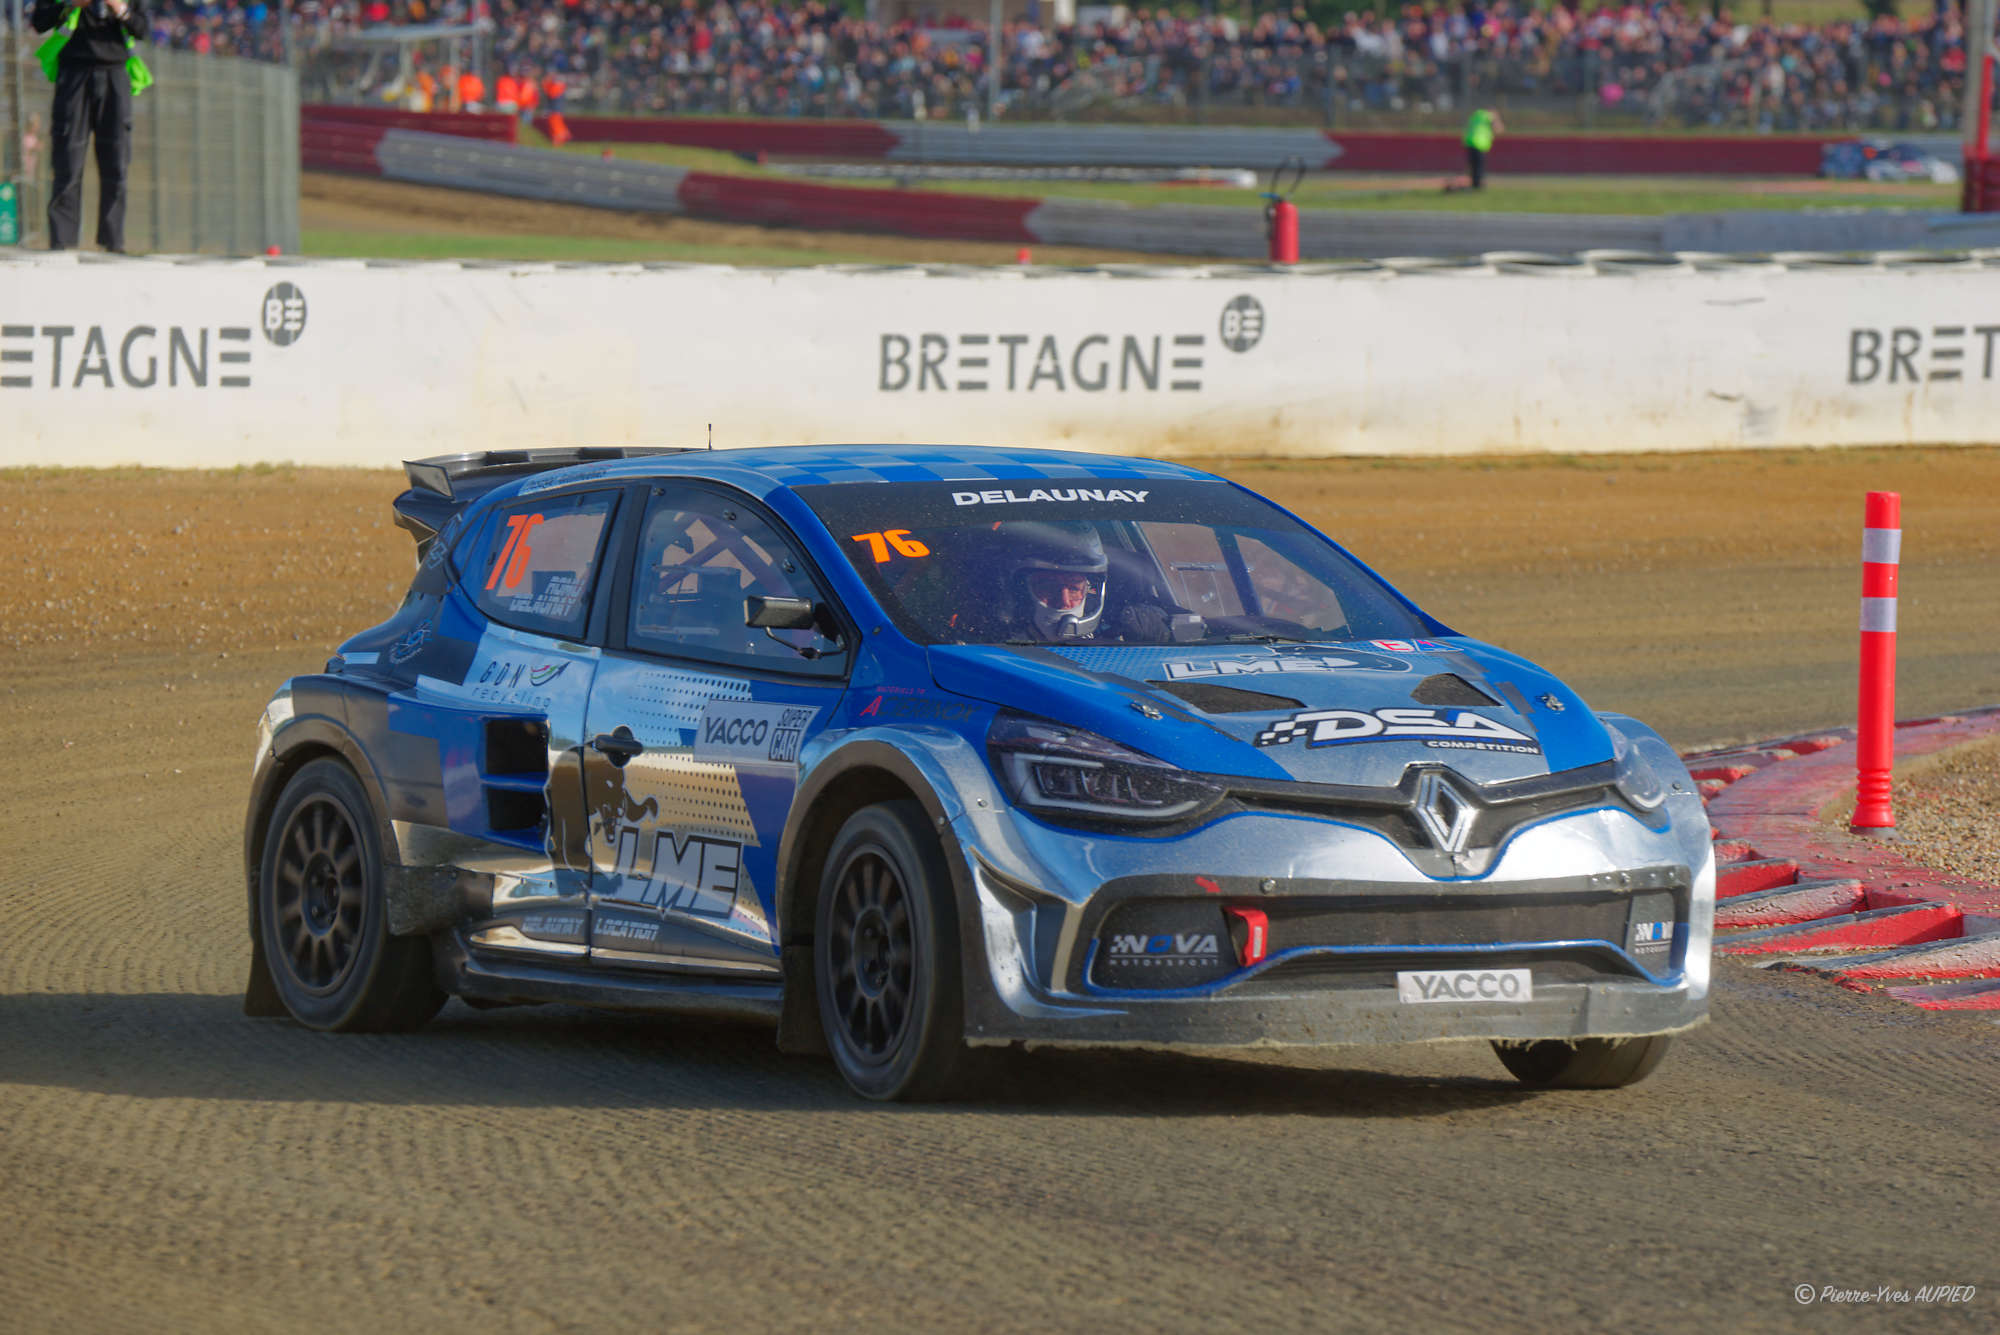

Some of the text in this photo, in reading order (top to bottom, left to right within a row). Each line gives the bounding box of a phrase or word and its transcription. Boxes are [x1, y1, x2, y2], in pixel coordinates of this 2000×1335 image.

[879, 333, 1205, 391] BRETAGNE
[1848, 325, 2000, 384] BRET
[952, 489, 1149, 506] DELAUNAY
[485, 513, 544, 590] 76
[851, 529, 930, 563] 76
[1163, 658, 1318, 681] LME
[704, 717, 769, 746] YACCO
[1294, 708, 1535, 744] DSA
[770, 730, 799, 761] CAR
[1426, 740, 1540, 754] COMPETITION
[598, 826, 742, 920] LME
[1412, 973, 1519, 999] YACCO
